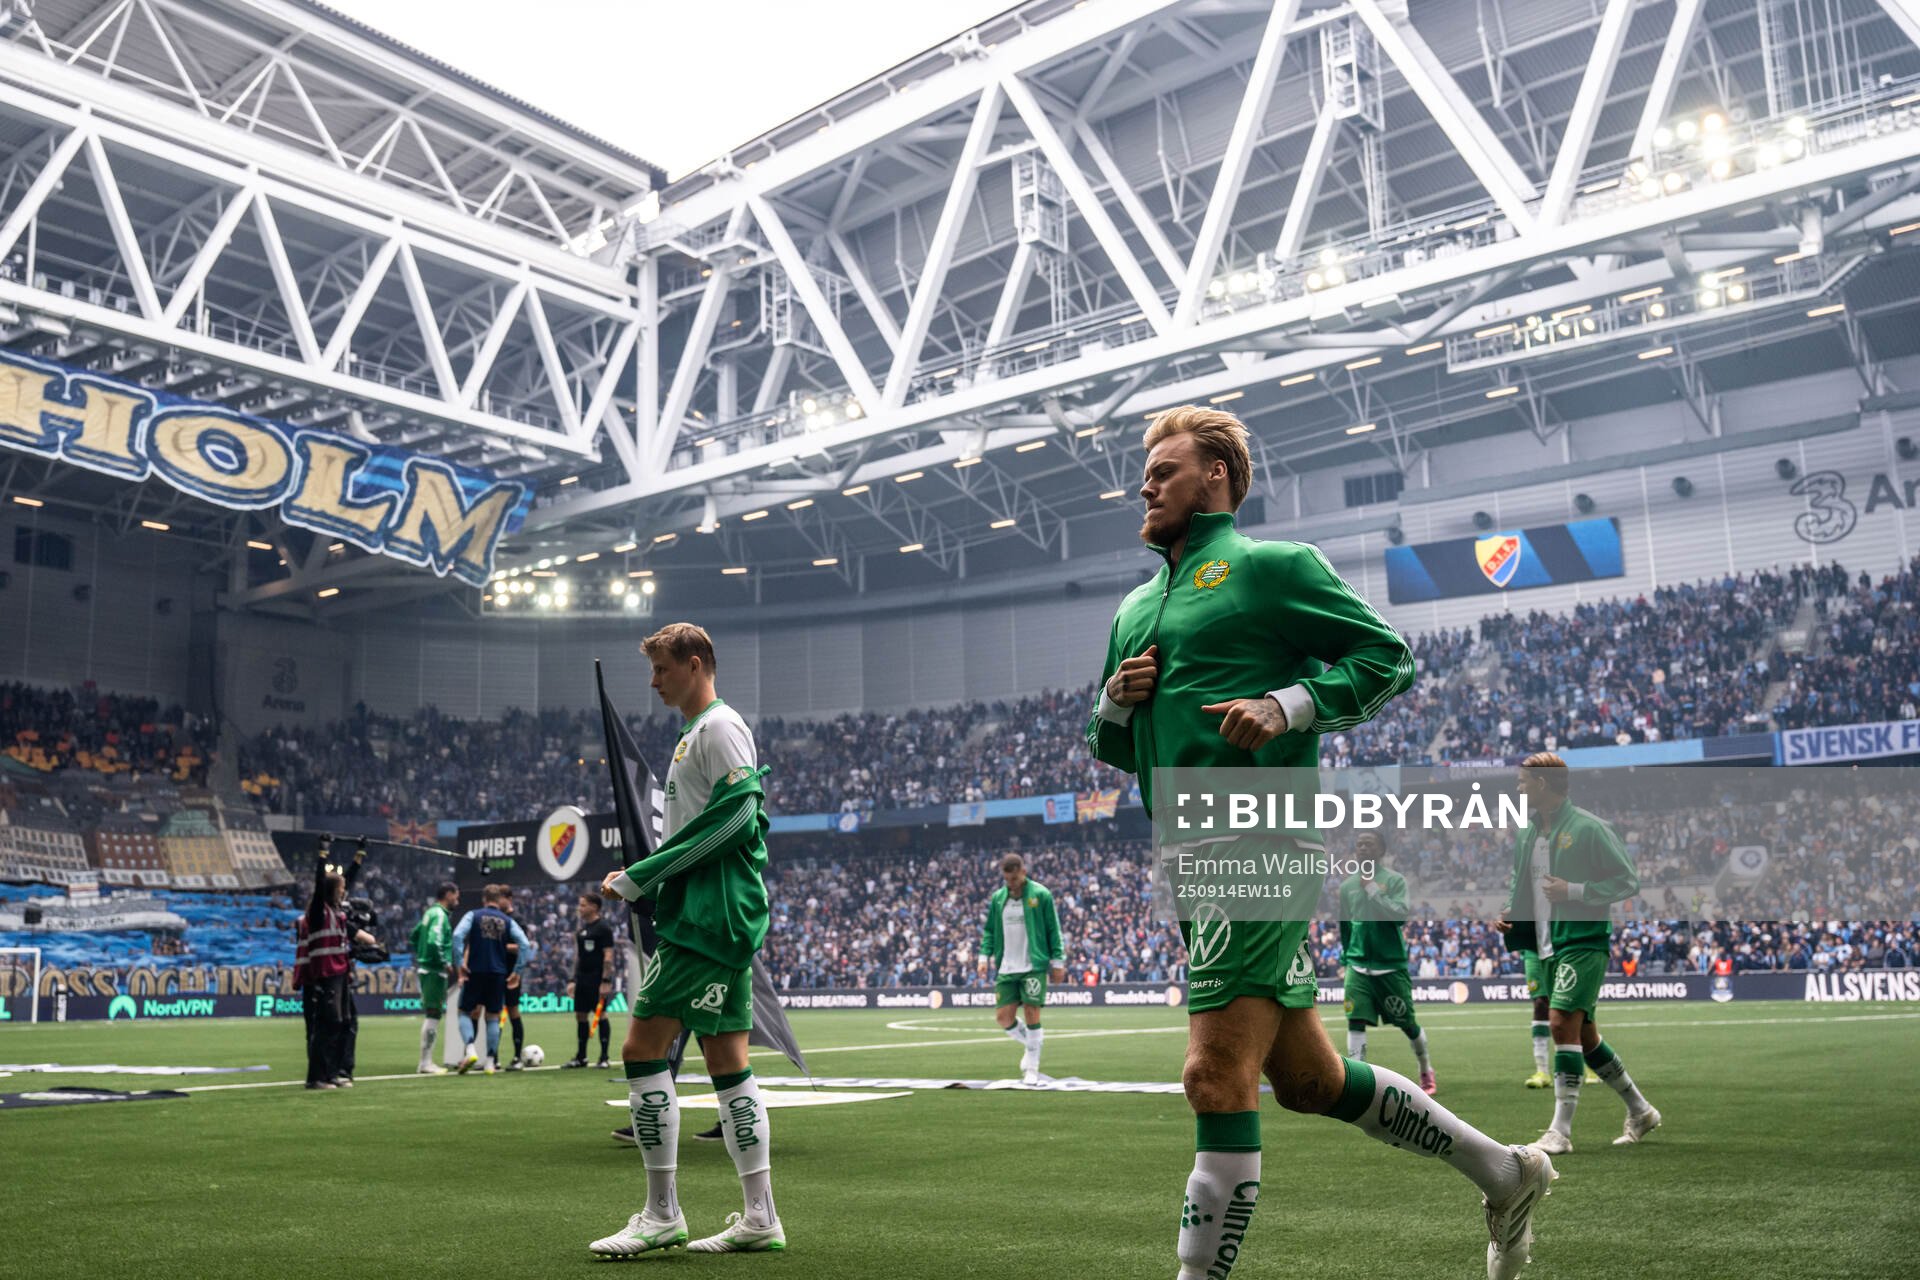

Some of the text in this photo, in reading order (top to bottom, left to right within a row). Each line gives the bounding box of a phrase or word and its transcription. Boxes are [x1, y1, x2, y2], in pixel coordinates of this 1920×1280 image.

[1789, 723, 1920, 760] SVENSK F
[467, 836, 527, 859] UNIBET
[1191, 979, 1214, 989] CRAFT
[1482, 984, 1508, 1000] WE
[790, 995, 811, 1007] YOU
[811, 995, 867, 1007] BREATHING
[951, 993, 969, 1005] WE
[1045, 991, 1092, 1004] EATHING
[144, 999, 215, 1016] NordVPN
